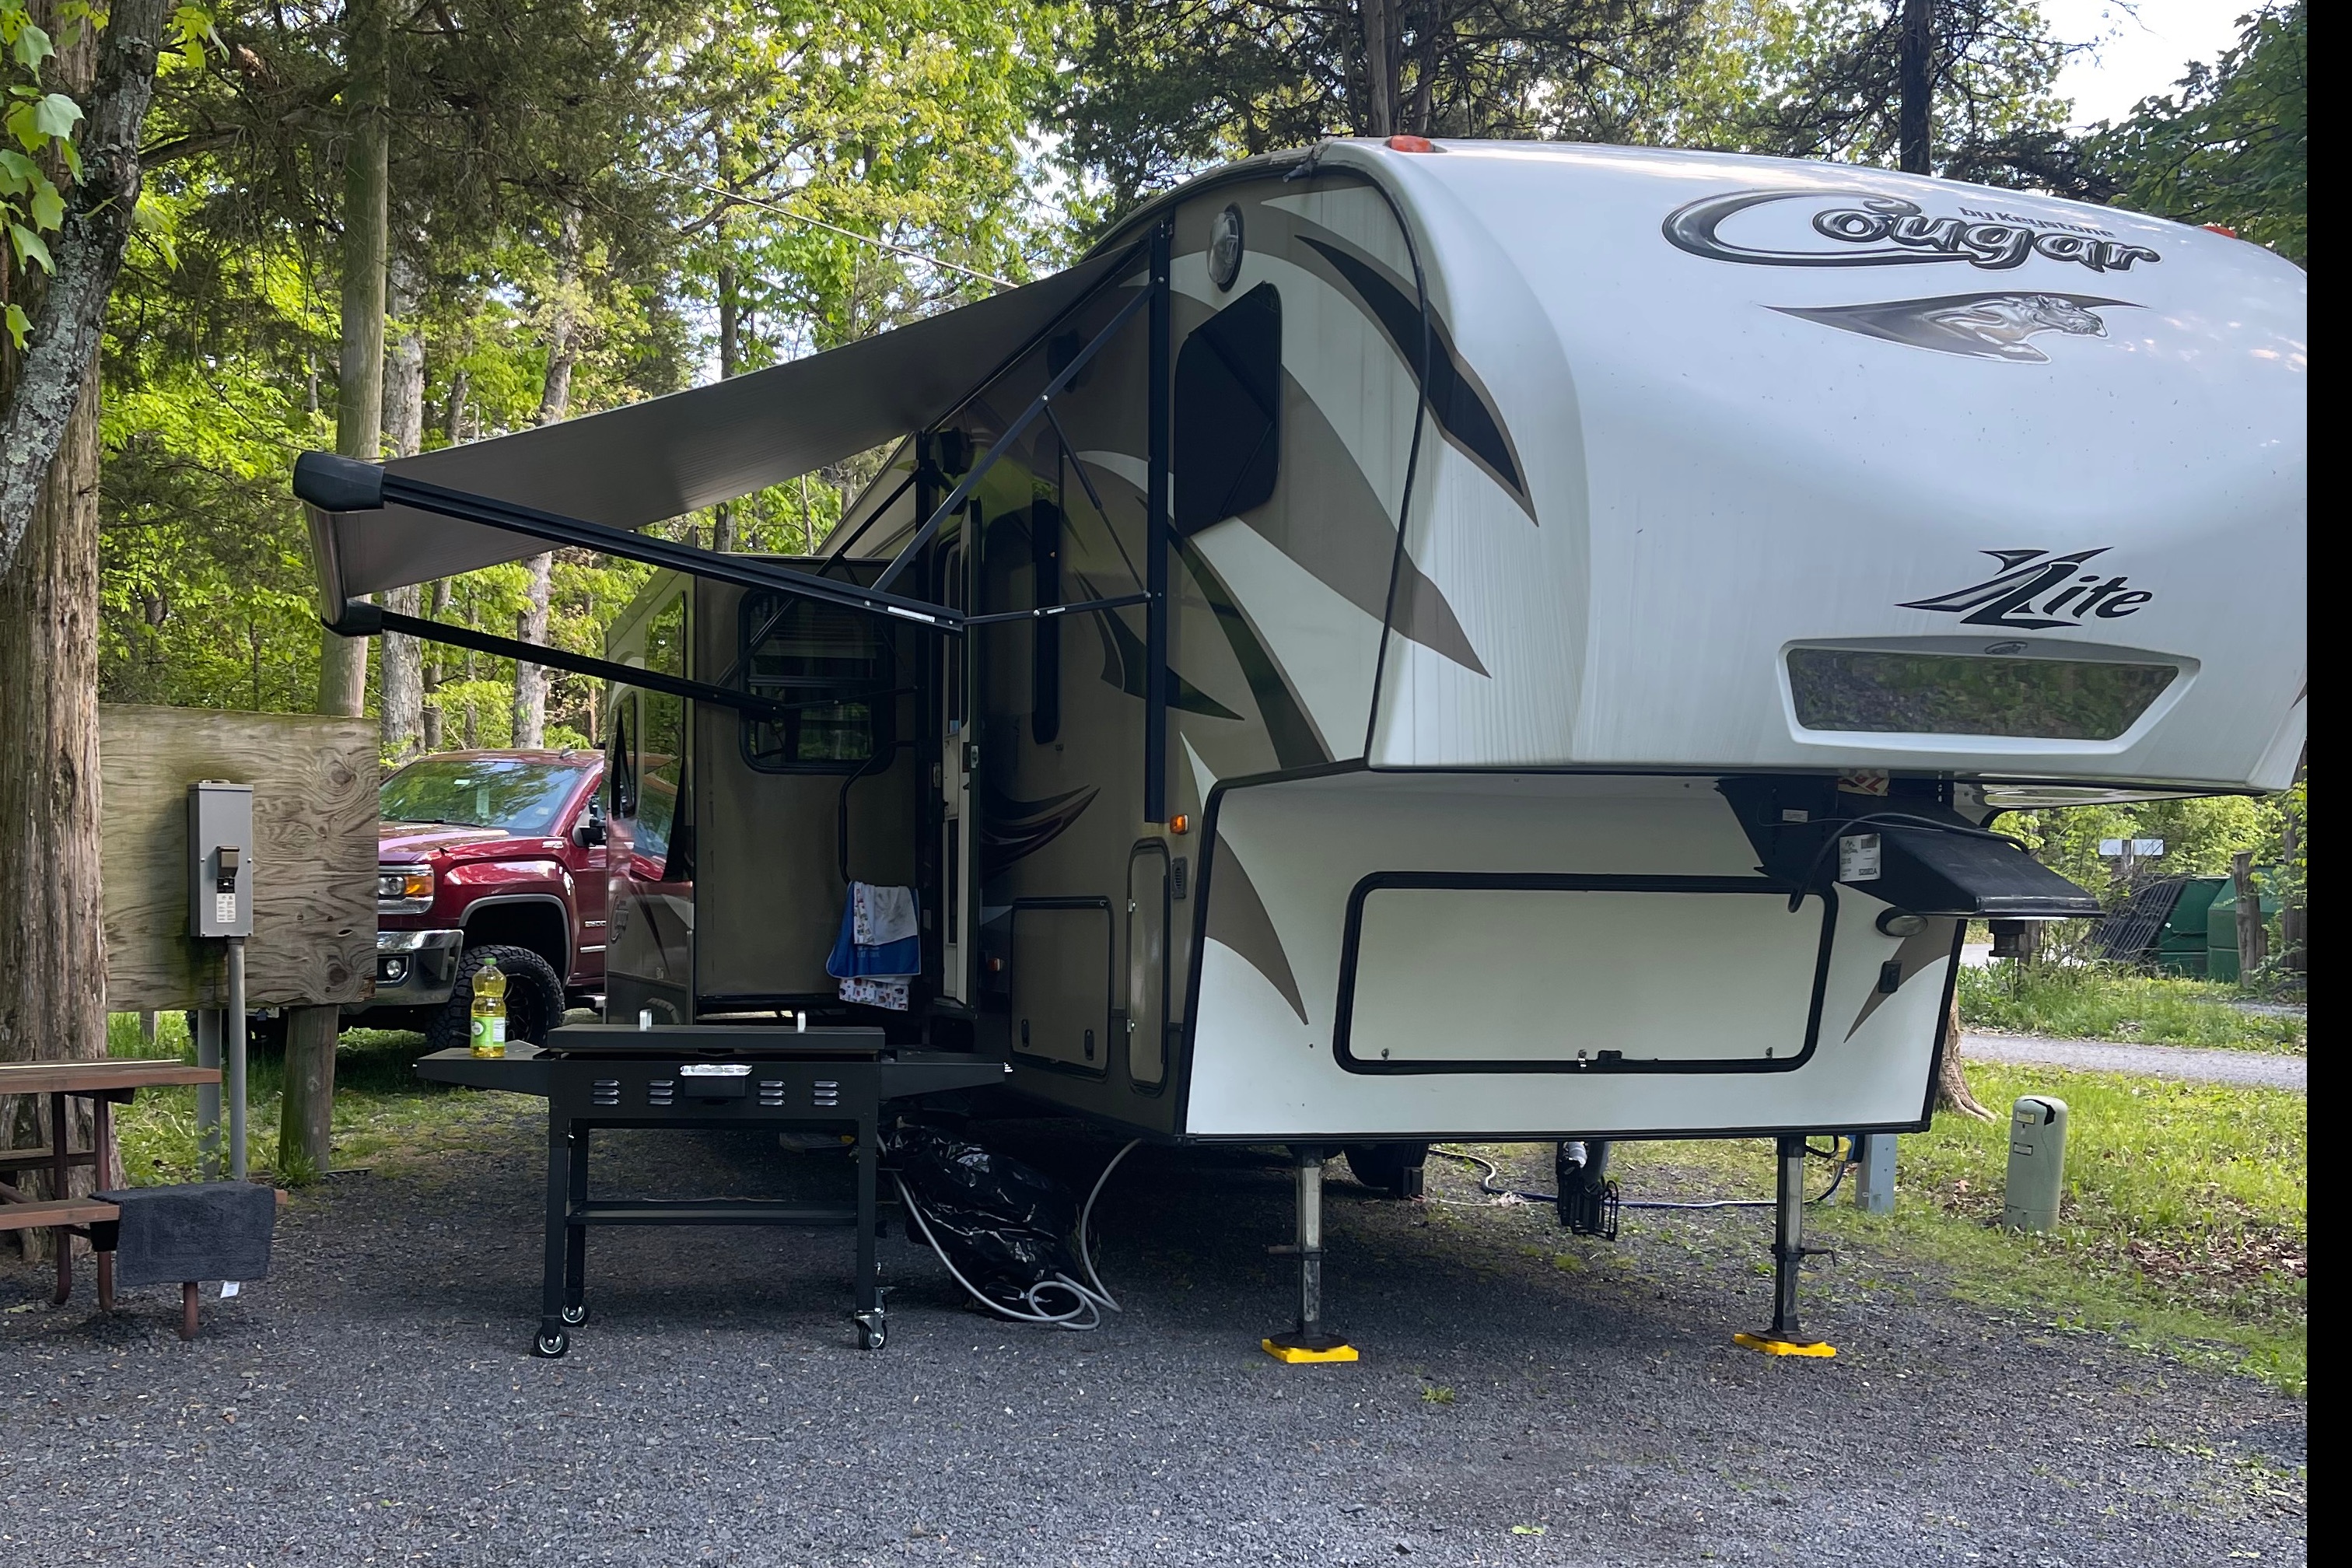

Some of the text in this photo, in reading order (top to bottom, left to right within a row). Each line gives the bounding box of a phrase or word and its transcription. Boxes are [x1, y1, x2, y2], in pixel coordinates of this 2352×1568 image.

[1661, 187, 2162, 272] Cougar
[1958, 206, 2117, 239] by Keystone
